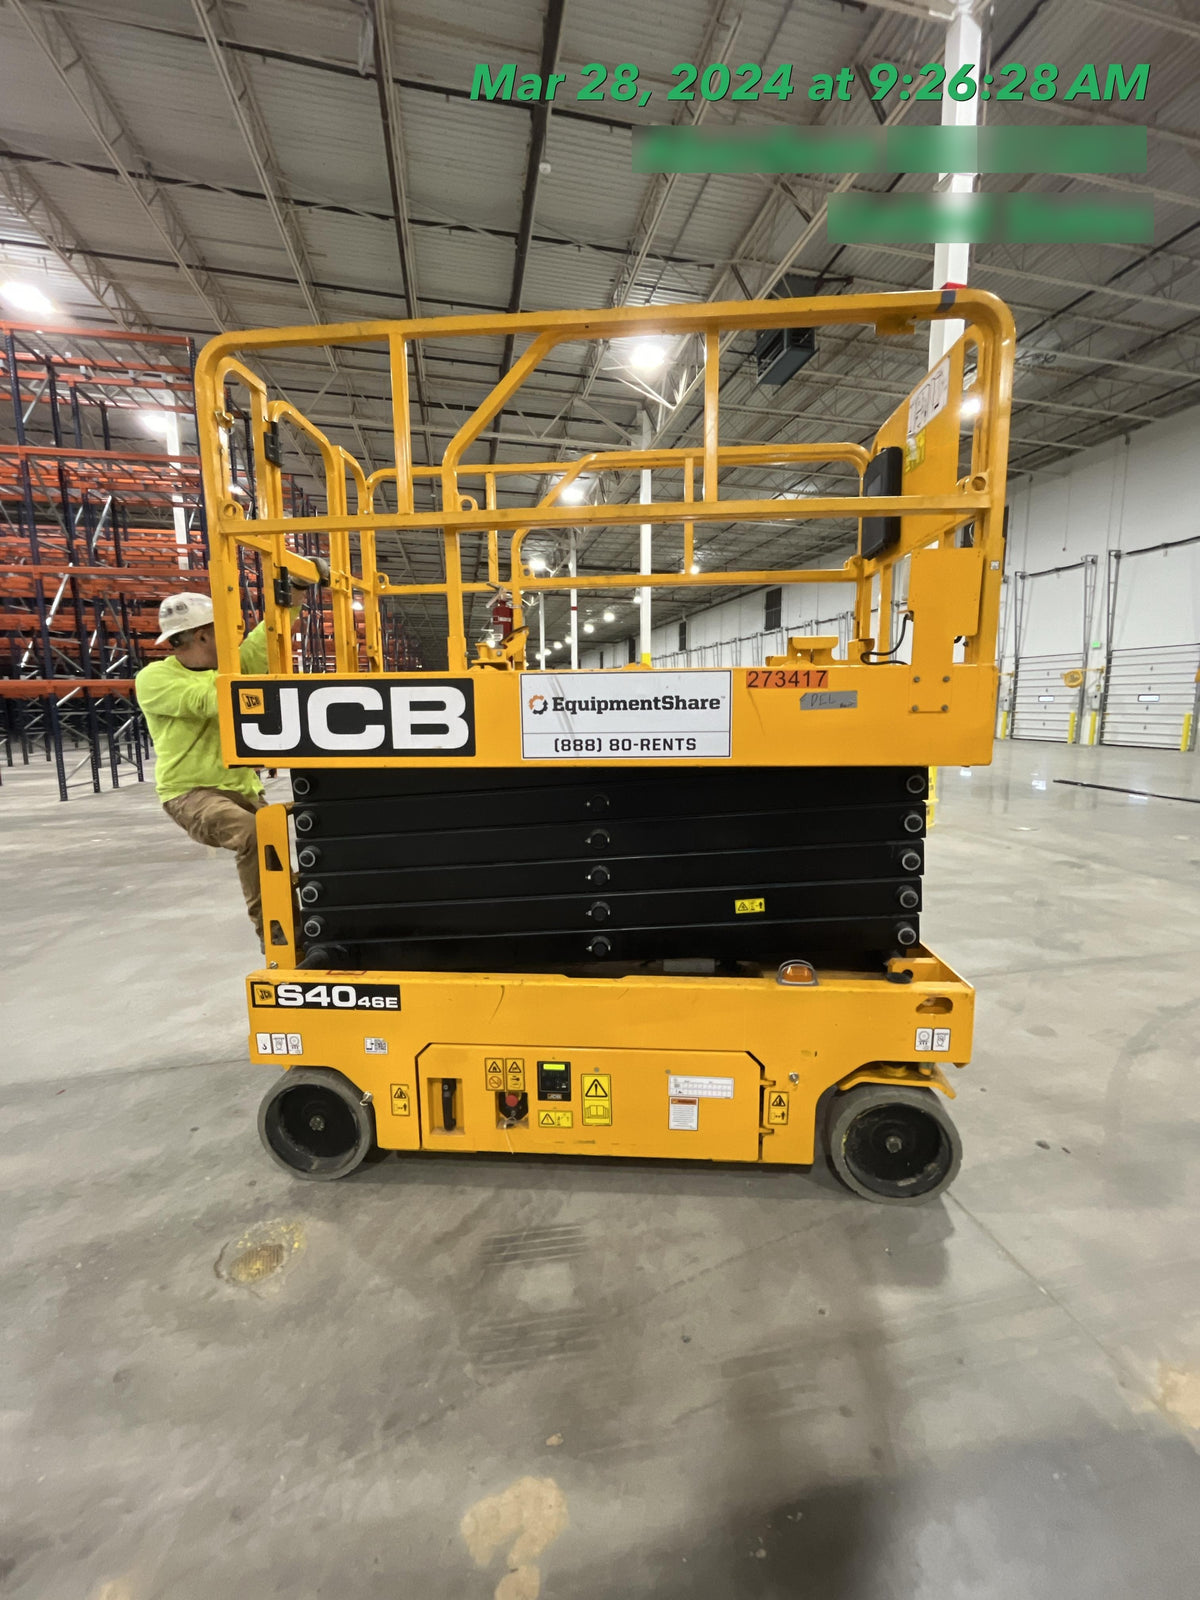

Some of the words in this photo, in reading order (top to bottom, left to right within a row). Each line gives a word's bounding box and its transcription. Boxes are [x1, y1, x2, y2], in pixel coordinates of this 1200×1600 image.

[747, 670, 828, 688] 273417
[552, 695, 721, 715] EquipmentShare
[241, 686, 469, 751] JCB
[554, 738, 602, 752] (888)
[609, 738, 697, 751] 80-RENTS
